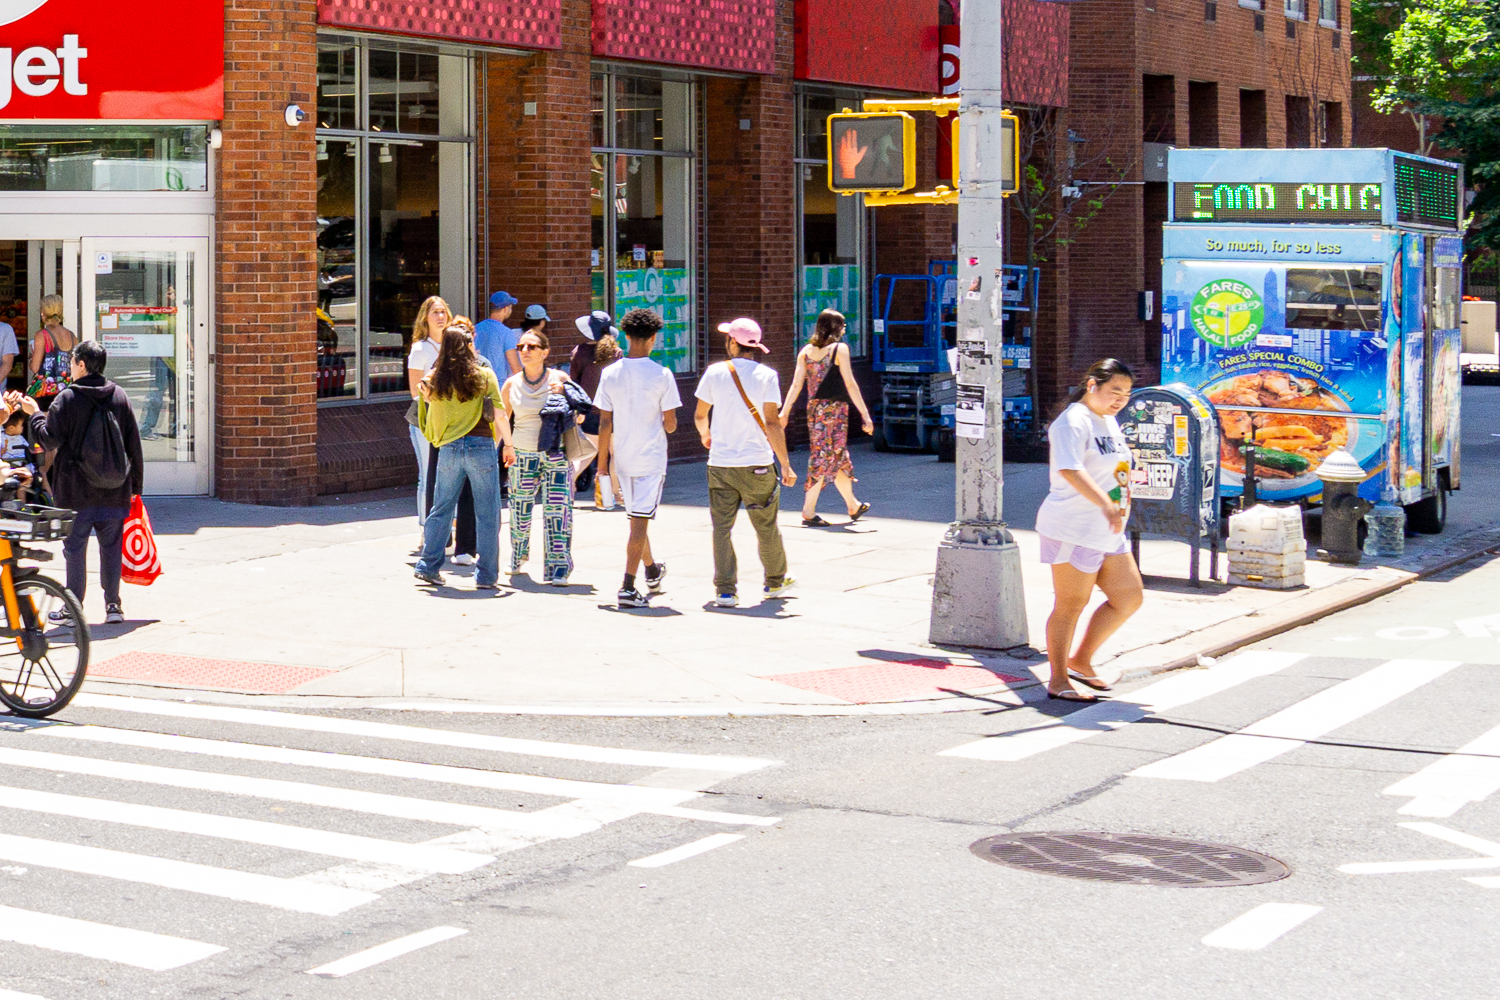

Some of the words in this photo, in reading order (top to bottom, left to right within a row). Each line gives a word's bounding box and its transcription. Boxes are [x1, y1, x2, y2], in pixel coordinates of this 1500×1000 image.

[1206, 238, 1223, 252] So
[1228, 238, 1267, 254] much,
[1271, 239, 1292, 254] for
[1295, 243, 1312, 254] so
[1315, 240, 1341, 254] less
[1200, 281, 1254, 299] FARES
[1194, 317, 1223, 344] HALAL
[1230, 323, 1257, 344] FOOD
[1219, 353, 1247, 369] FARES
[1248, 351, 1285, 361] SPECIAL
[1287, 354, 1324, 373] COMBO
